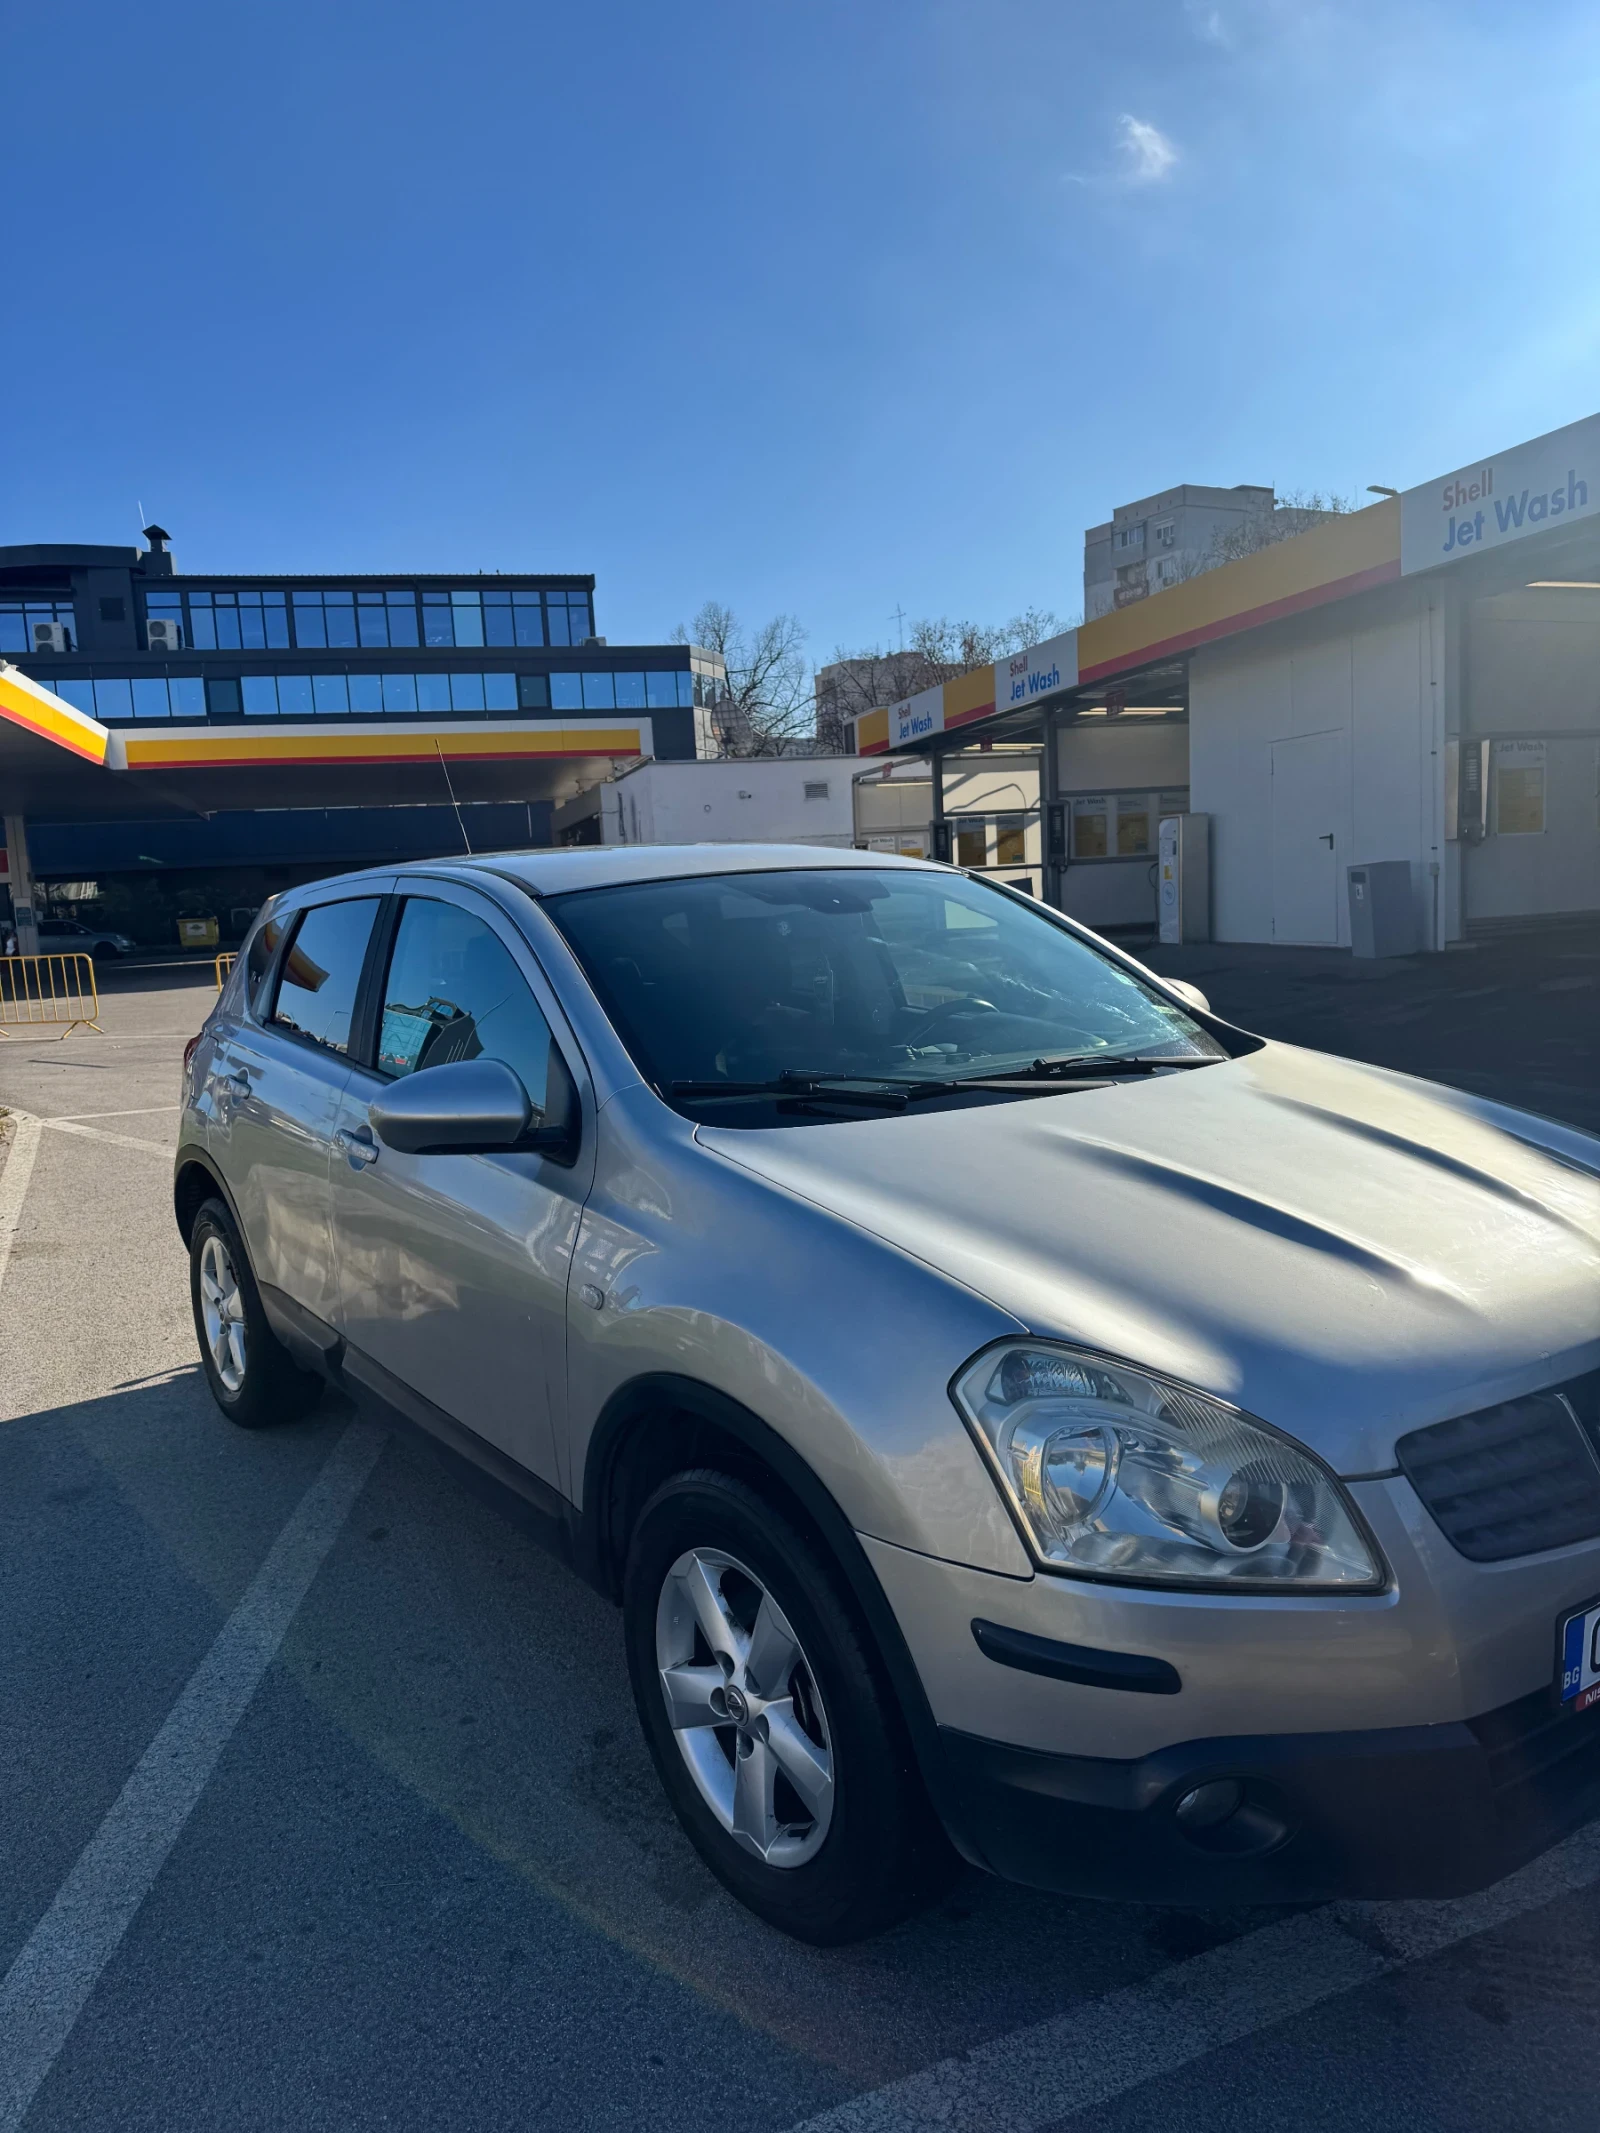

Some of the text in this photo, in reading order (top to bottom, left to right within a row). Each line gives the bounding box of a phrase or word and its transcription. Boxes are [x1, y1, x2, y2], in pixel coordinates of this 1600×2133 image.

[1443, 468, 1493, 511] Shell
[1442, 469, 1588, 552] Jet Wash
[1009, 655, 1028, 678] Shell
[1010, 663, 1060, 701] Jet Wash
[898, 703, 911, 720] Shell
[899, 711, 933, 740] Jet Wash
[1517, 740, 1544, 751] Wash
[1563, 1666, 1580, 1690] BG
